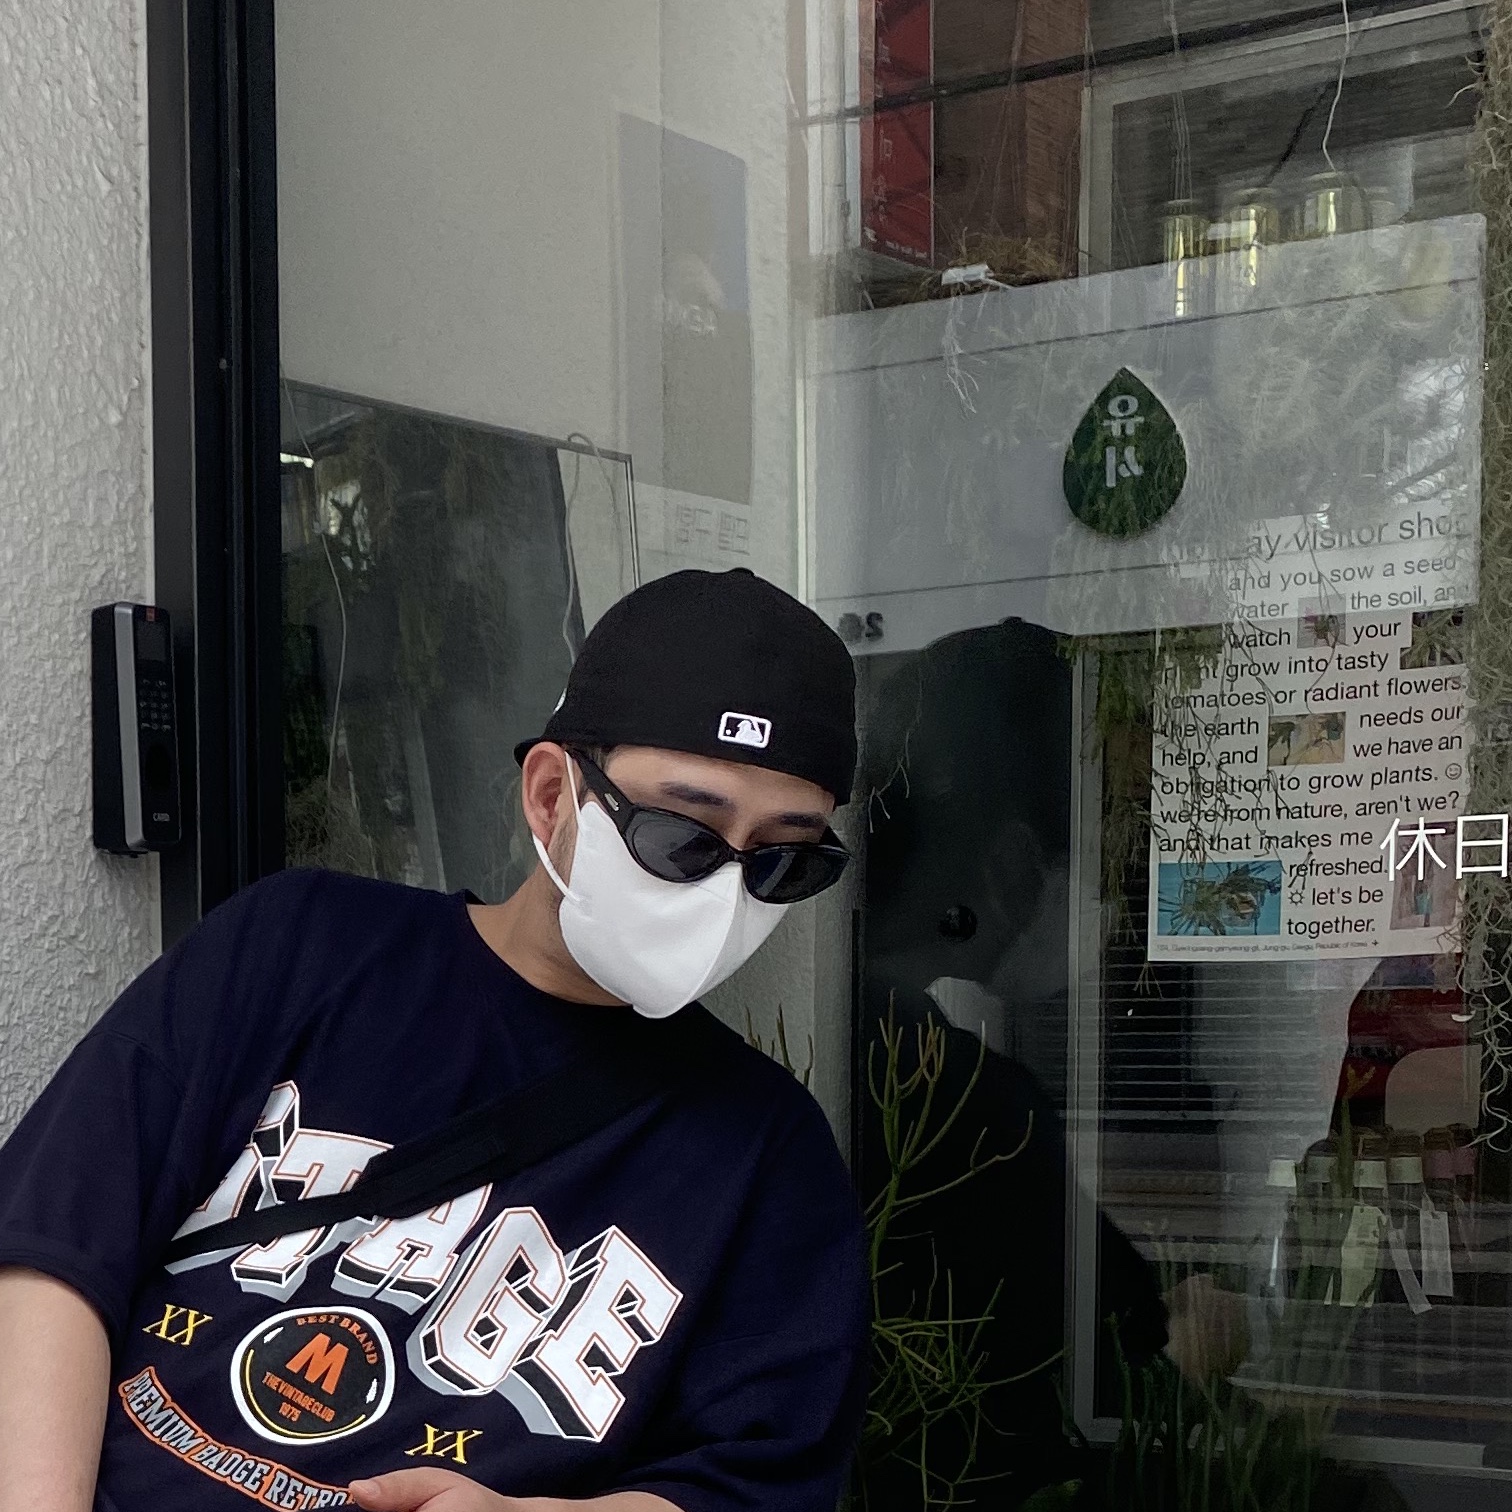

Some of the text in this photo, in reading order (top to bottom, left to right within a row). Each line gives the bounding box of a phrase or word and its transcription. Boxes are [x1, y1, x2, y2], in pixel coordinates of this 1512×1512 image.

[1229, 570, 1271, 591] and
[1280, 571, 1322, 592] you
[1330, 565, 1374, 583] sow
[1383, 562, 1395, 577] a
[1350, 592, 1383, 611] the
[1387, 585, 1427, 607] soil,
[1228, 628, 1291, 649] watch
[1353, 620, 1402, 645] your
[1226, 659, 1280, 682] grow
[1288, 655, 1329, 674] into
[1337, 651, 1389, 673] tasty
[1274, 688, 1296, 704] or
[1304, 680, 1380, 702] radiant
[1387, 675, 1467, 697] flowers.
[1161, 717, 1259, 738] the earth
[1359, 704, 1464, 728] needs our
[1161, 746, 1258, 769] help, and
[1352, 735, 1462, 758] we have an
[1279, 774, 1300, 791] to
[1308, 773, 1364, 794] grow
[1370, 765, 1438, 790] plants.
[1160, 790, 1460, 823] were from nature, aren't we?
[1159, 830, 1373, 852] and that makes me
[1380, 814, 1509, 881] 休日
[1289, 855, 1388, 878] refreshed.
[1312, 886, 1384, 906] let's be
[1287, 915, 1376, 939] together.
[142, 1303, 213, 1345] XX
[296, 1314, 378, 1365] BEST BRAND
[285, 1332, 349, 1395] M
[123, 1370, 206, 1454] PREMIUM
[191, 1442, 271, 1490] BADGE
[404, 1424, 483, 1464] XX
